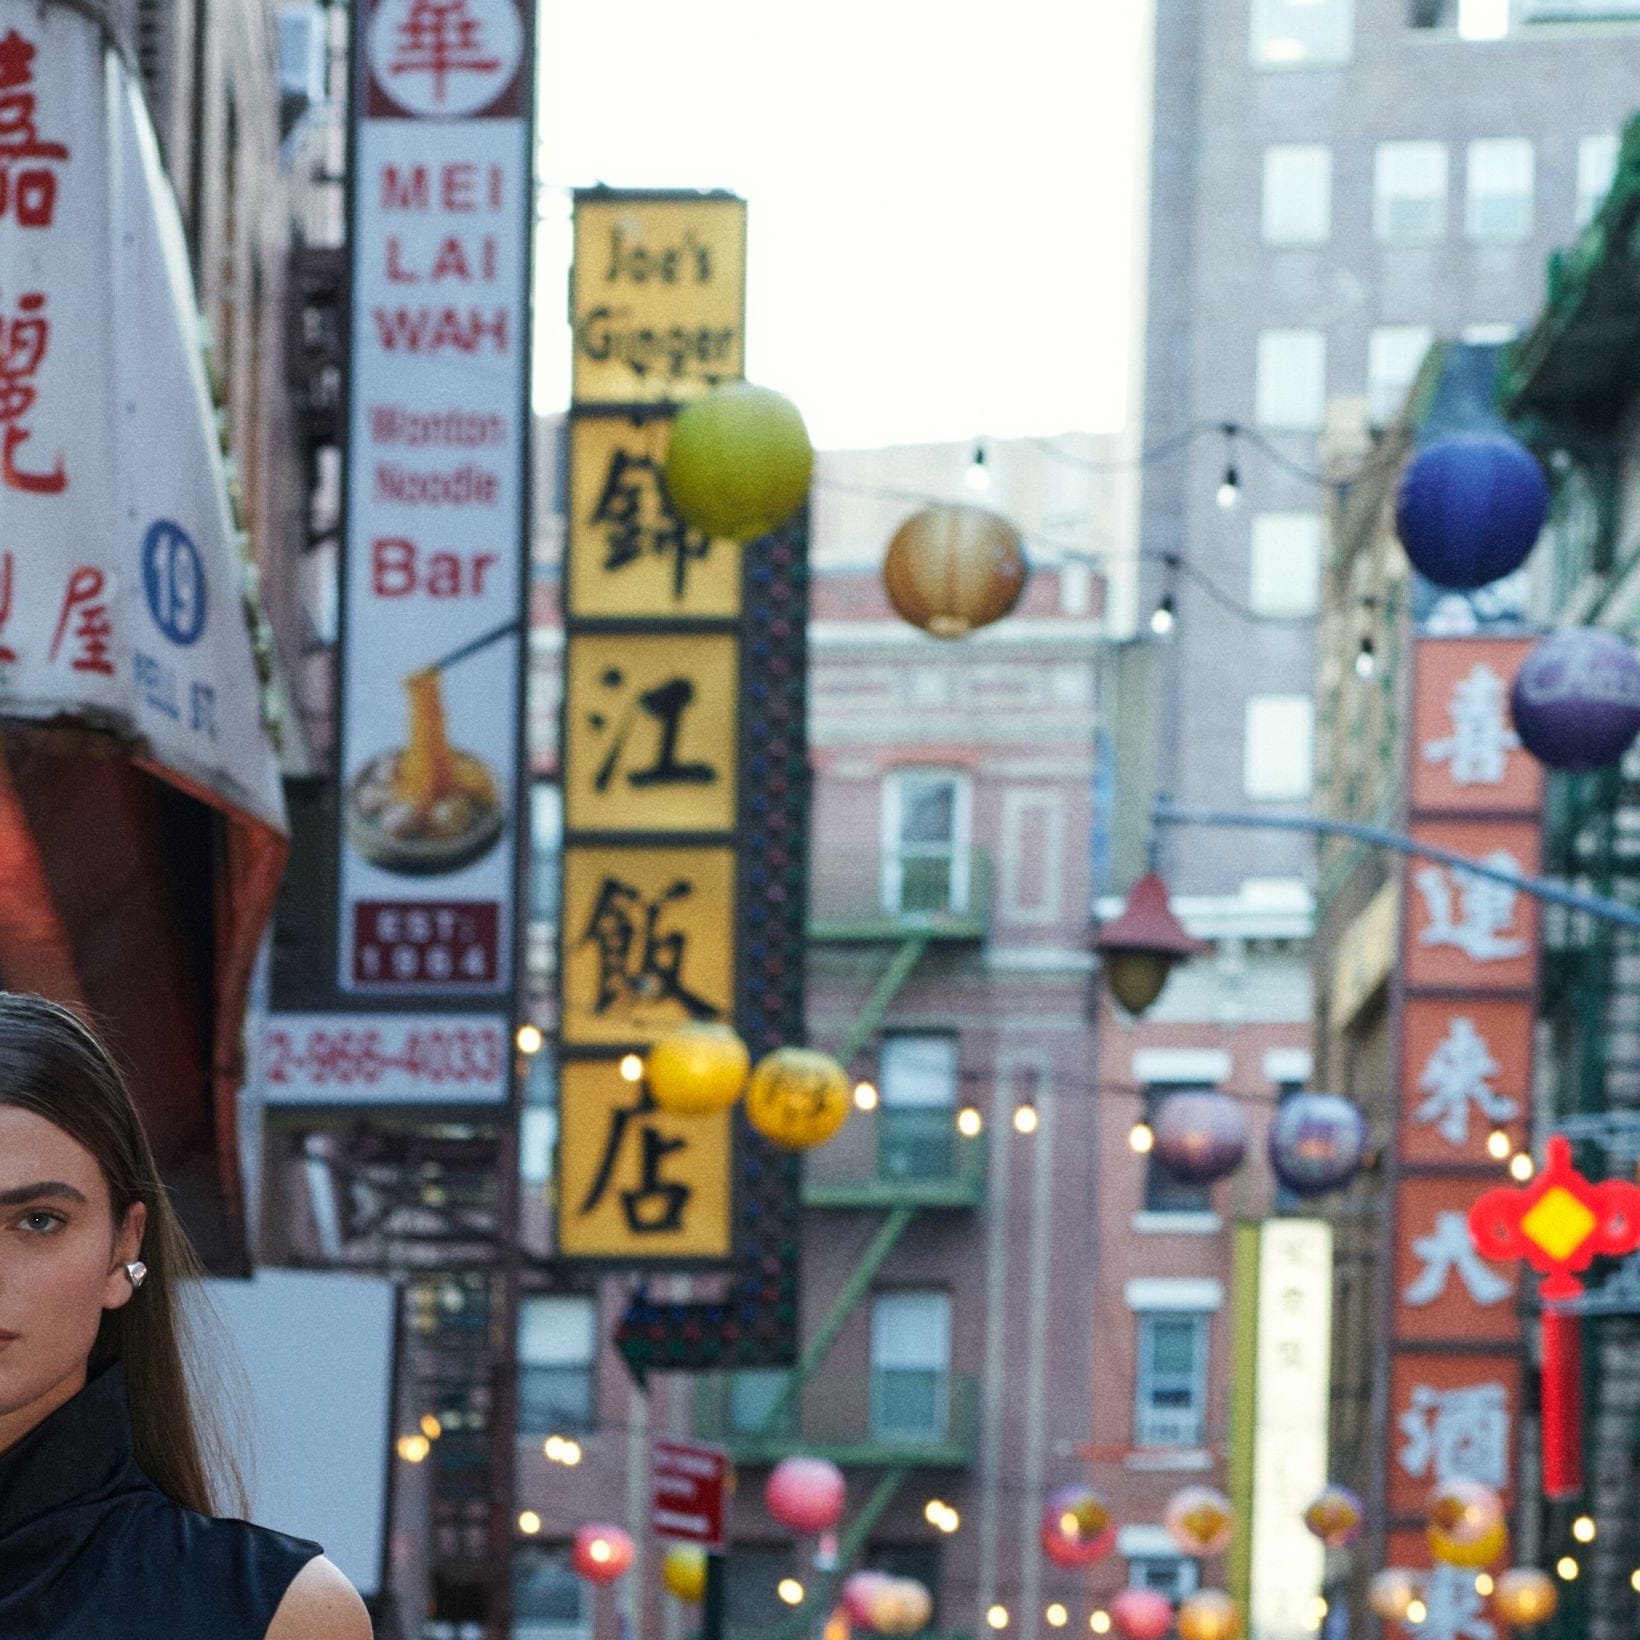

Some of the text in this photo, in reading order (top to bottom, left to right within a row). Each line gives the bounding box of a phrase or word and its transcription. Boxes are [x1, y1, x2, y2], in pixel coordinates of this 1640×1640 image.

[380, 163, 503, 213] MEI
[385, 236, 498, 284] LAI
[605, 226, 714, 284] Joe's
[372, 306, 508, 356] WAH
[368, 405, 505, 447] Wonton
[373, 463, 500, 507] Noodle
[153, 531, 198, 635] 19
[370, 537, 499, 599] Bar
